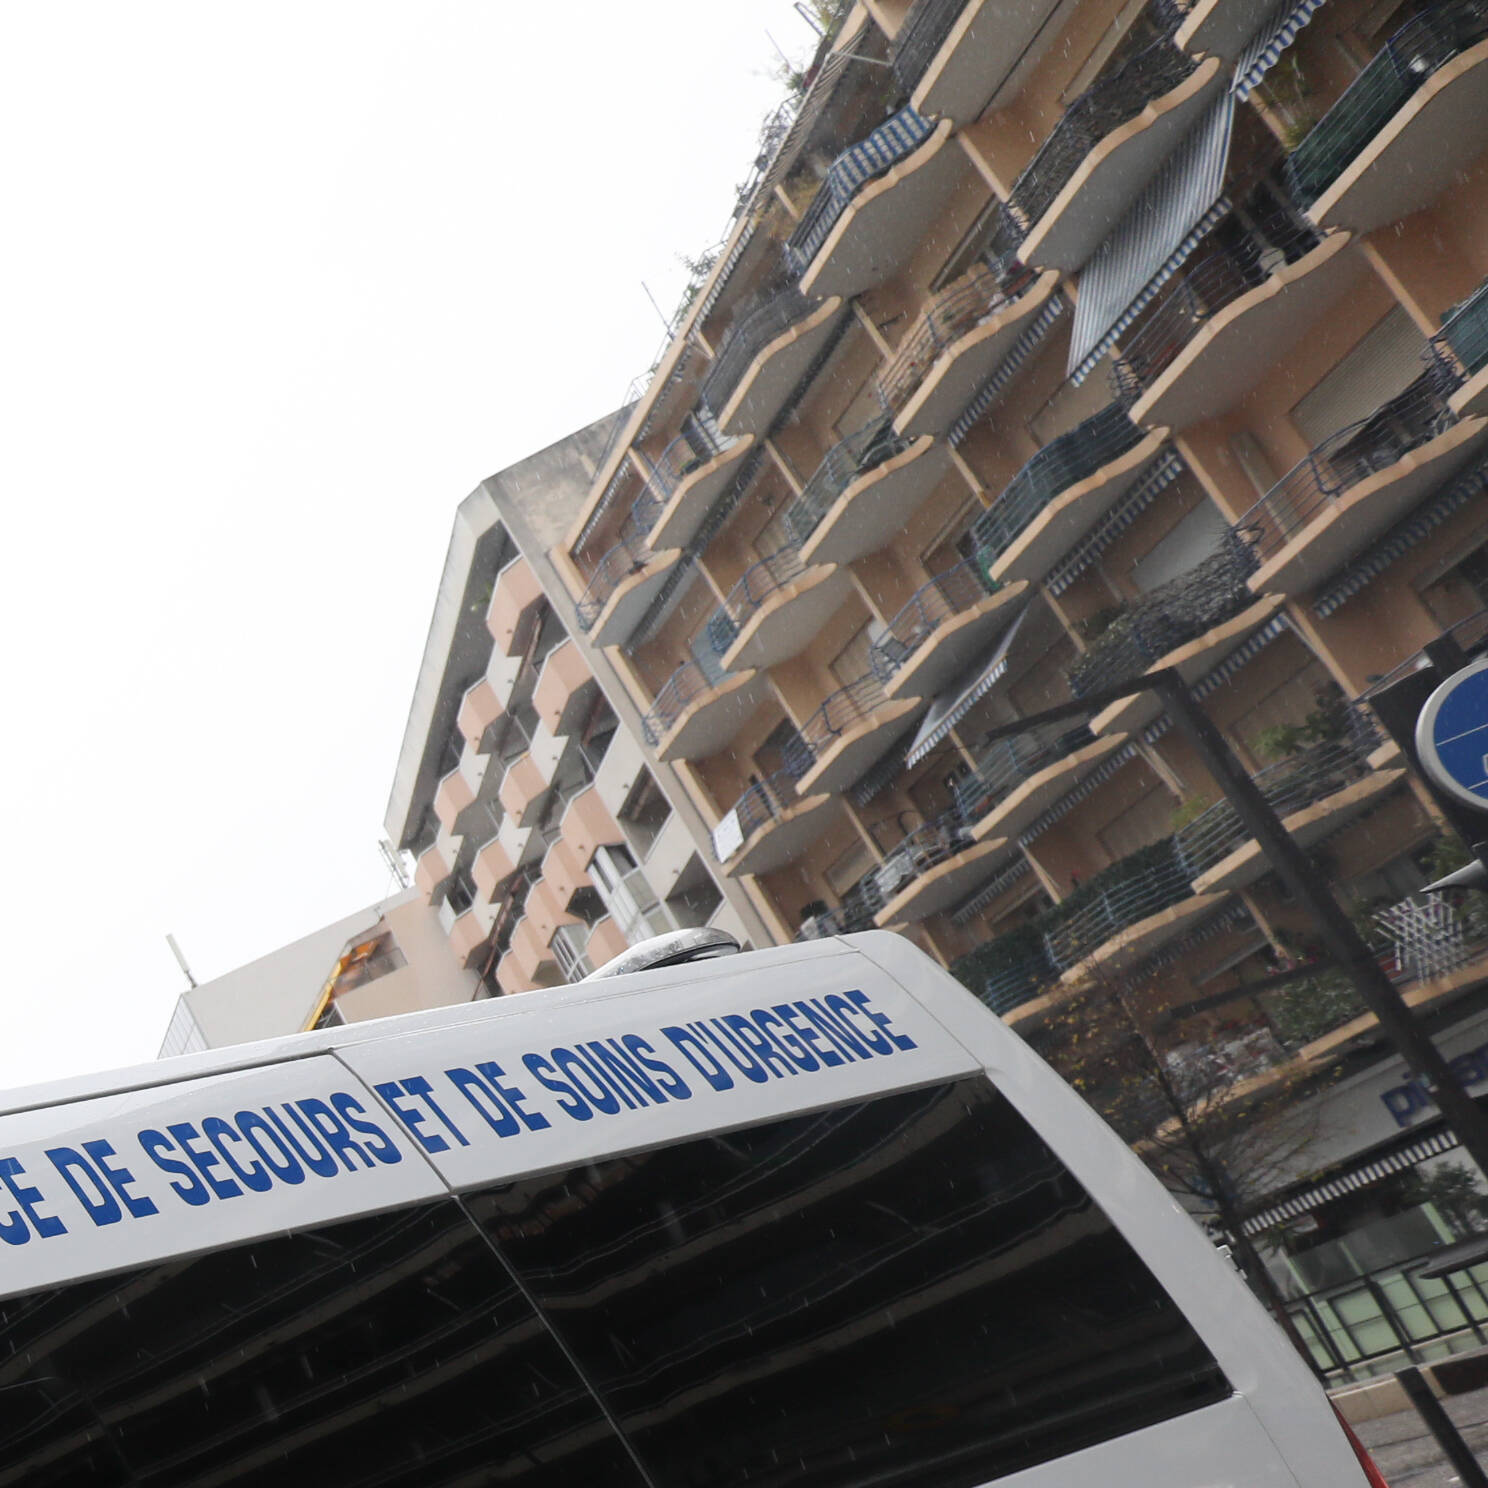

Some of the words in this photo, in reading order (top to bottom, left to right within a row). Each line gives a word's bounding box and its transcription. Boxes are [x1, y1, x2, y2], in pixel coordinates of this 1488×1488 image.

[44, 1138, 159, 1227] DE
[136, 1092, 403, 1206] SECOURS
[373, 1075, 471, 1155] ET
[446, 1061, 552, 1139] DE
[521, 1034, 692, 1122] SOINS
[660, 989, 918, 1092] D'URGENCE
